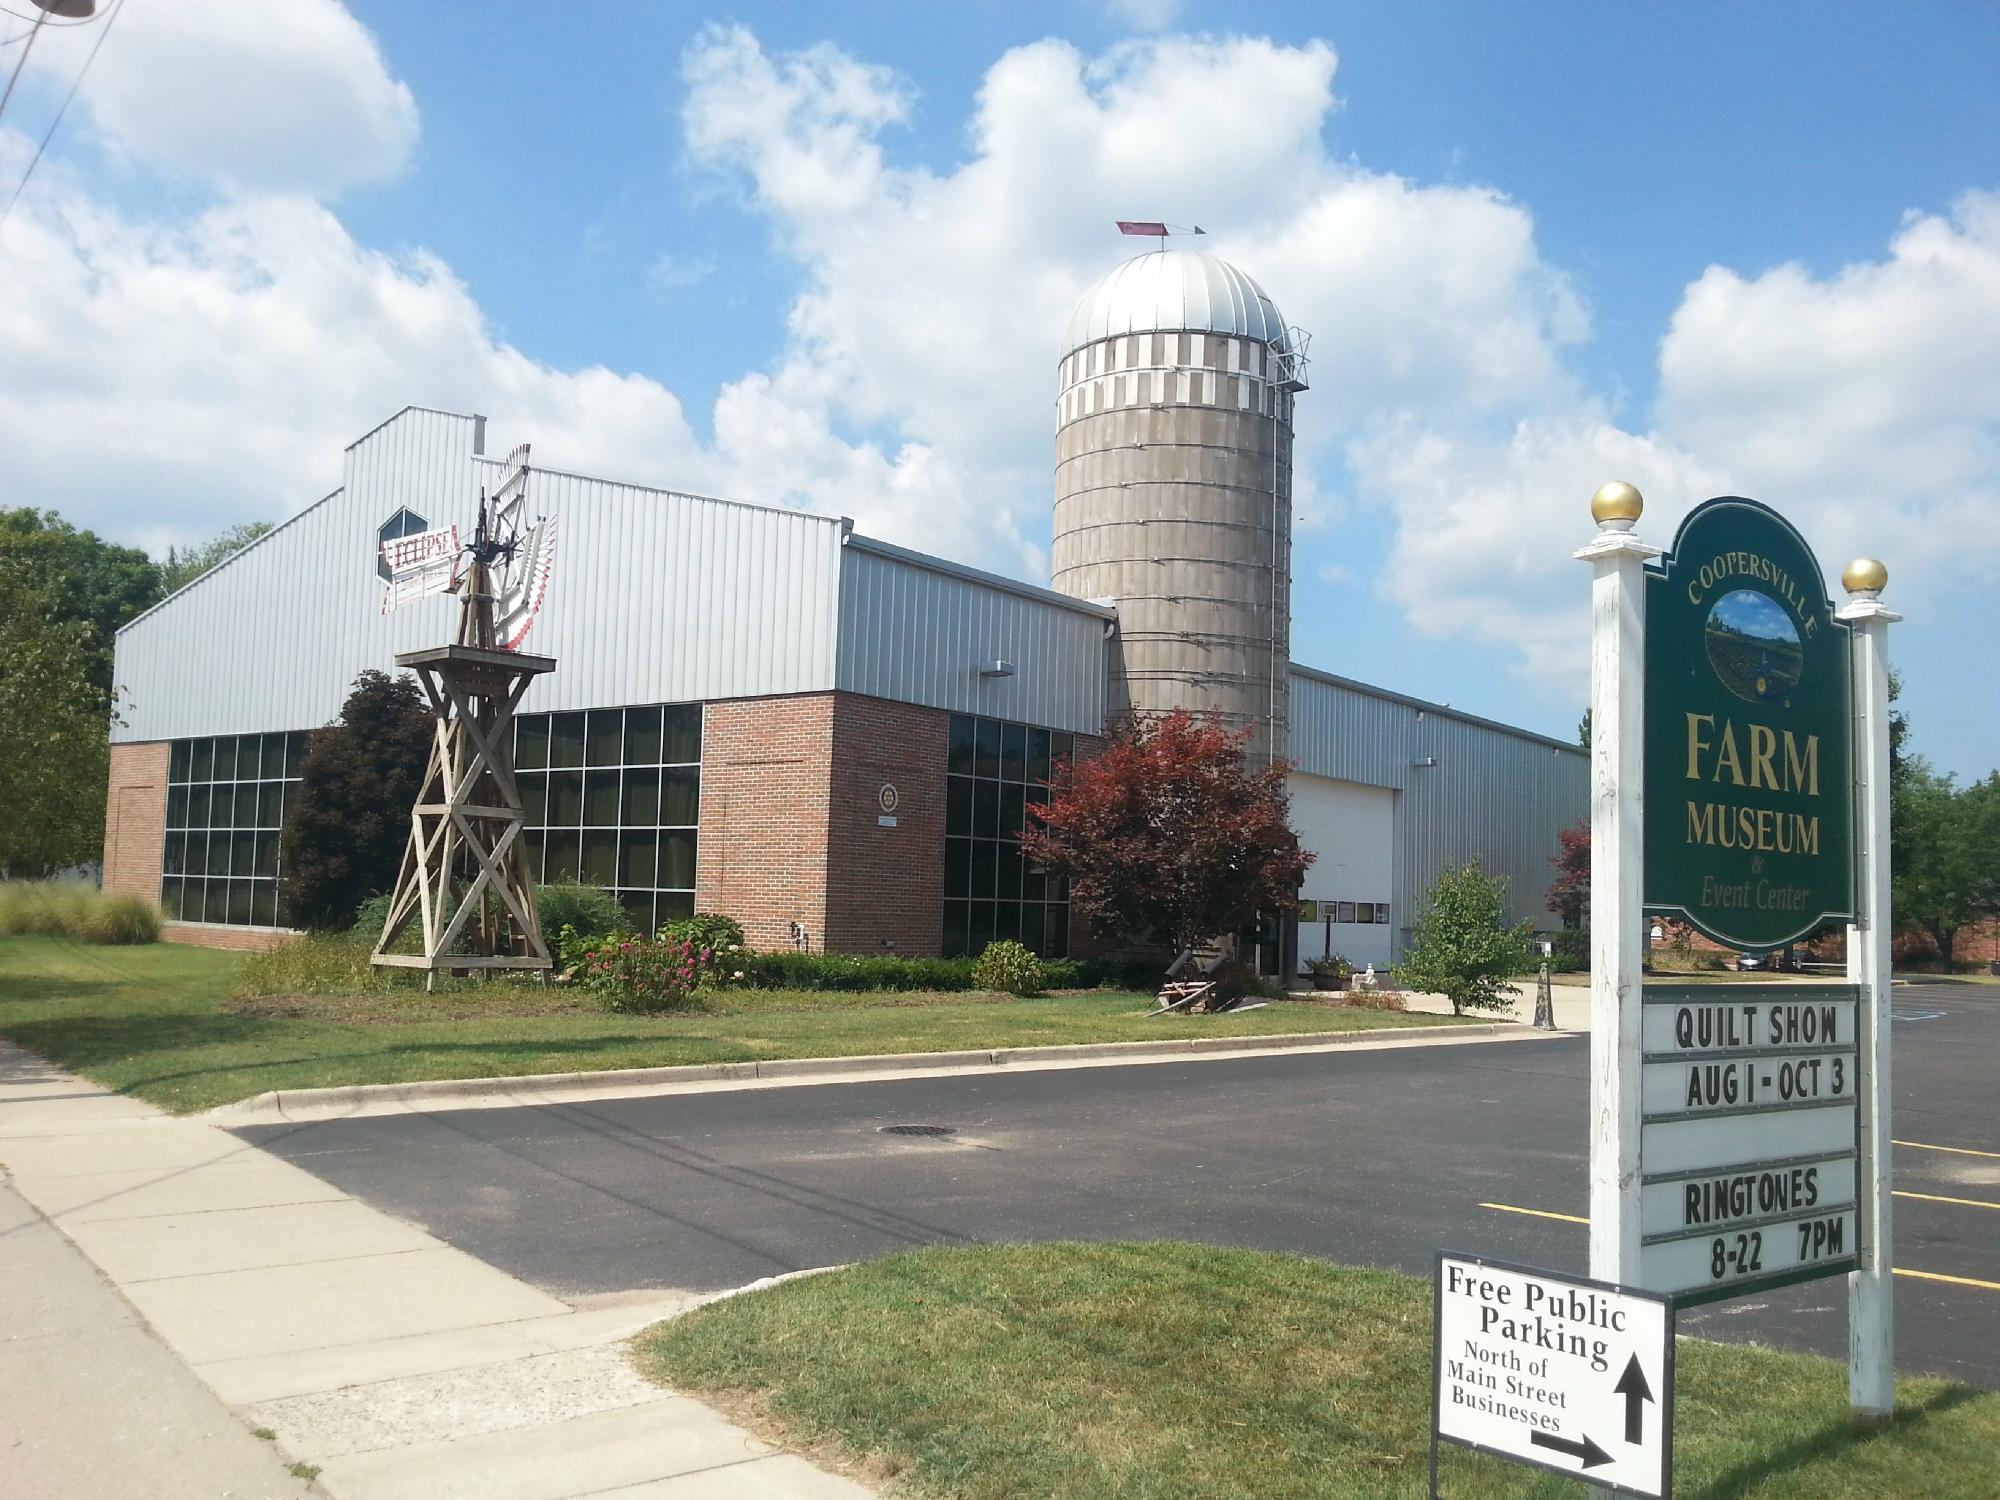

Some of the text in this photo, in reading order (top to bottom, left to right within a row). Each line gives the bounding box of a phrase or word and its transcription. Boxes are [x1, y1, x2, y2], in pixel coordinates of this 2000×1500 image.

[1688, 552, 1819, 640] COOPERSVILLE
[1685, 712, 1820, 796] FARM
[1686, 801, 1820, 856] MUSEUM
[1751, 855, 1765, 875] &
[1701, 875, 1811, 912] Event Center
[1676, 1006, 1837, 1048] QUILT SHOW
[1685, 1167, 1818, 1225] RINGTONES
[1711, 1216, 1843, 1279] 8-22 7PM
[1448, 1265, 1626, 1332] Free Public
[1464, 1340, 1549, 1379] North of
[1480, 1305, 1608, 1372] Parking
[1447, 1359, 1567, 1409] Main Street
[1452, 1385, 1560, 1432] Businesses
